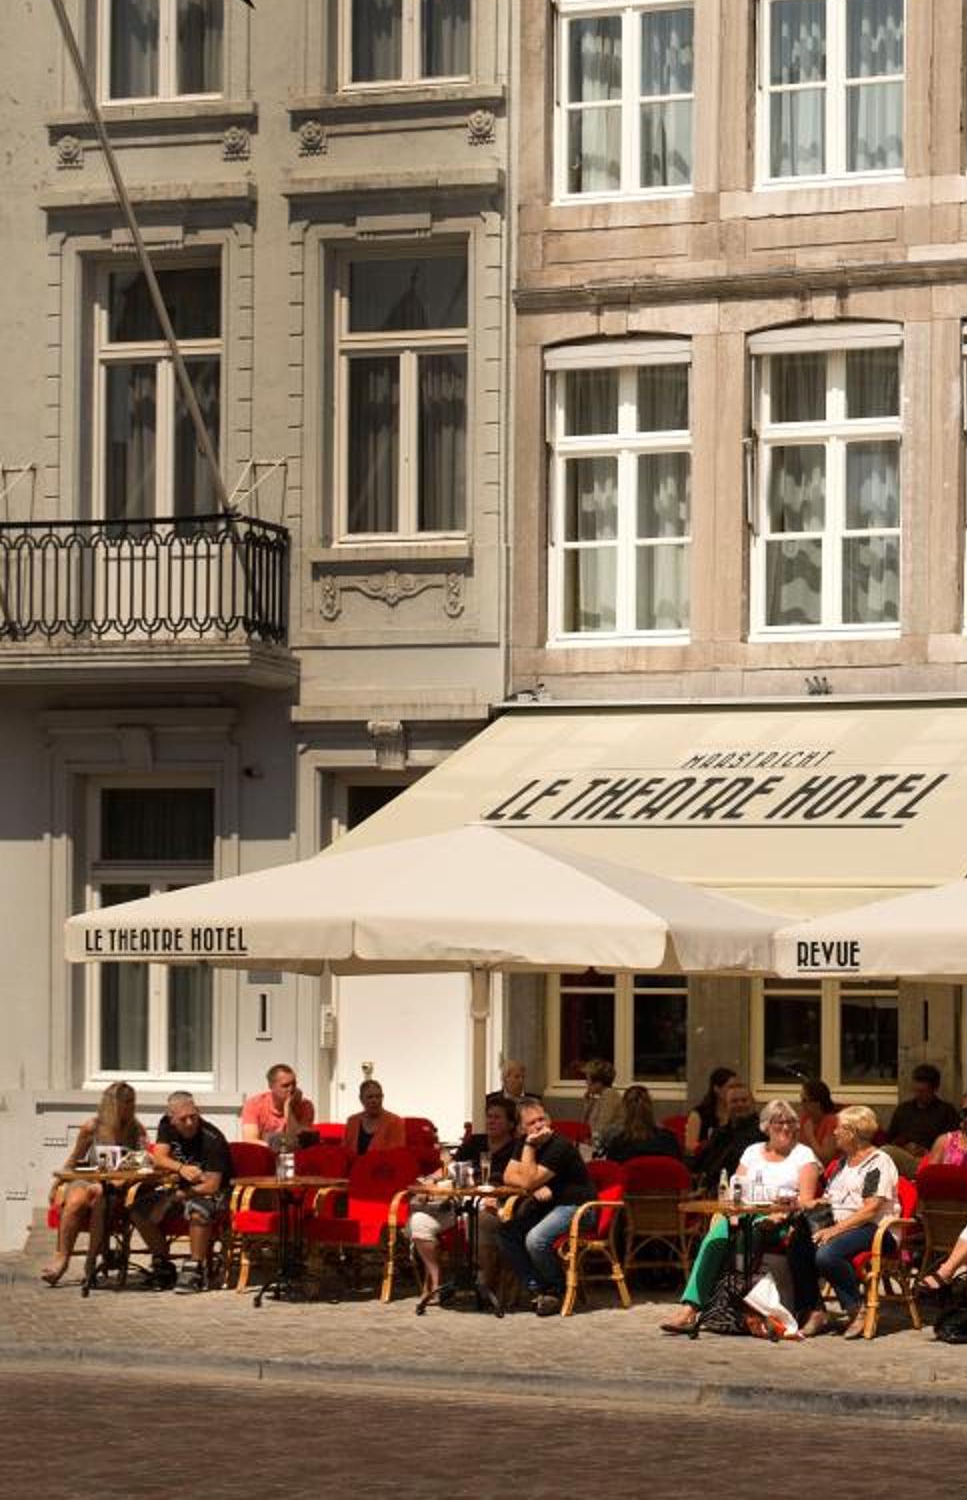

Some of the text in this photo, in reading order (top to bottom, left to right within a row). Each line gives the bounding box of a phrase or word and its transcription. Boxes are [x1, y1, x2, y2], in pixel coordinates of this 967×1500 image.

[681, 750, 834, 768] MAASTRICHT
[484, 773, 948, 820] LE THEATRE HOTEL
[85, 926, 248, 951] LE THEATRE HOTEL
[797, 941, 860, 967] REVUE
